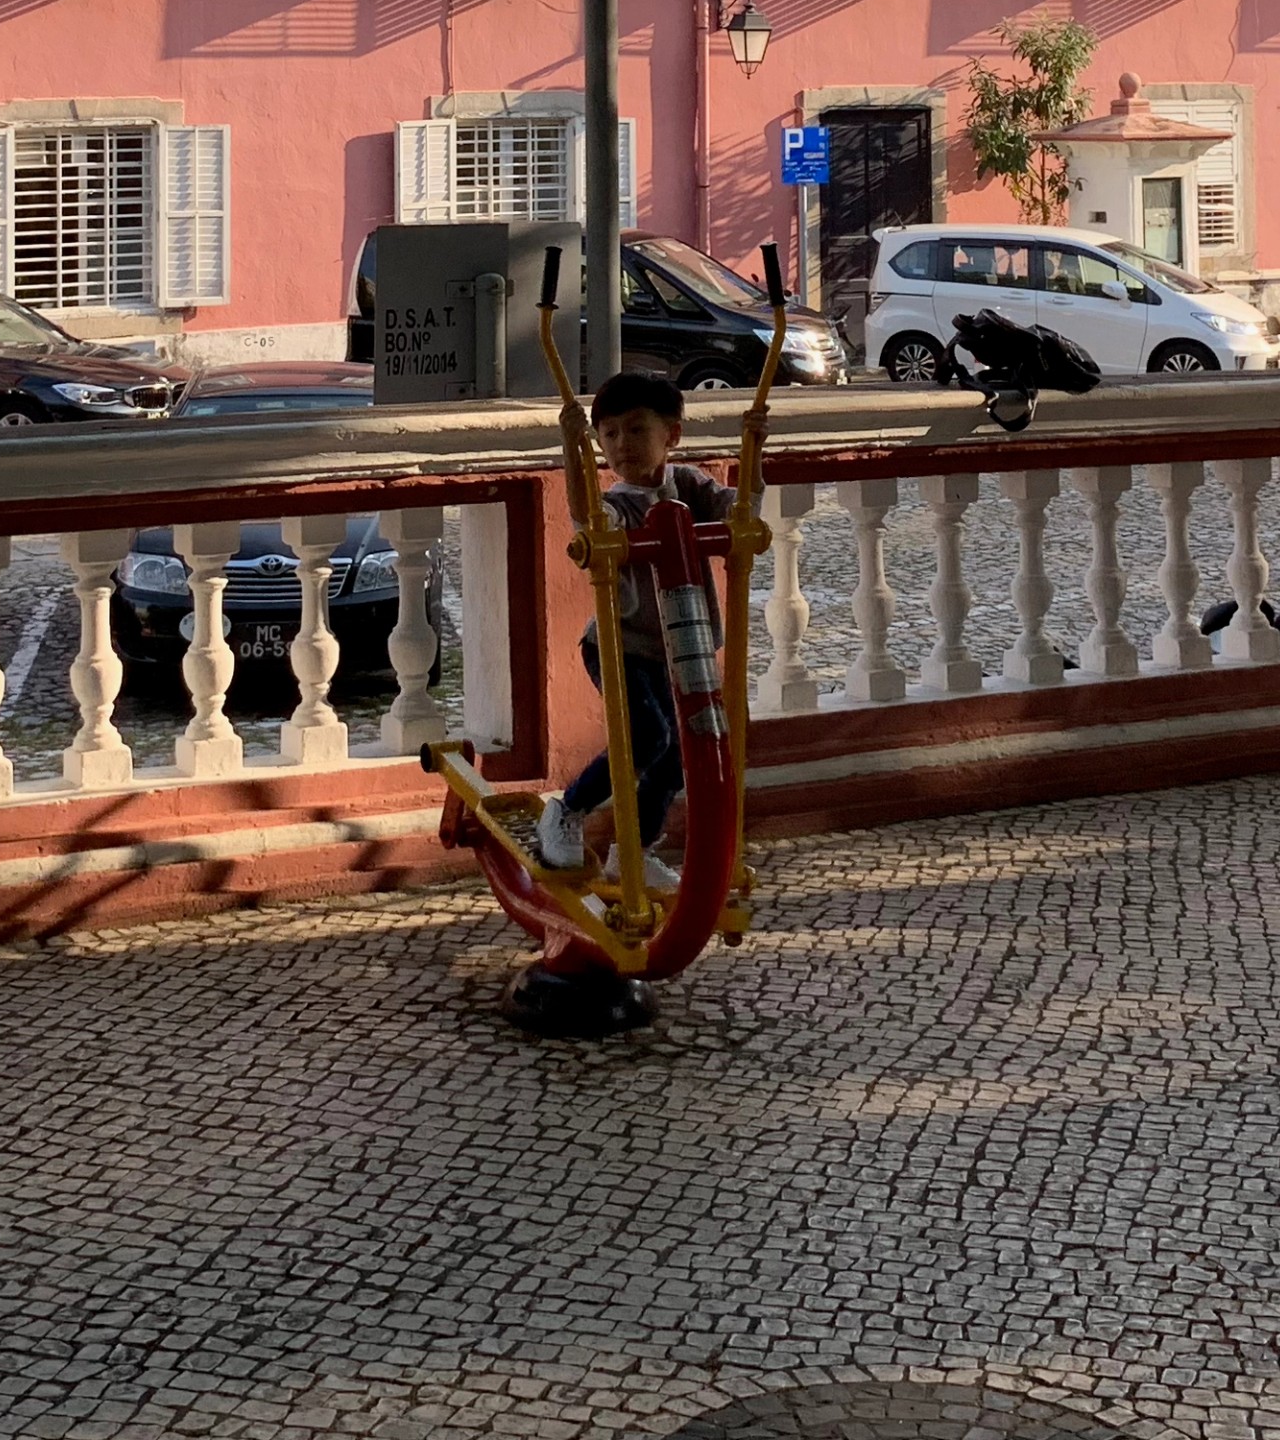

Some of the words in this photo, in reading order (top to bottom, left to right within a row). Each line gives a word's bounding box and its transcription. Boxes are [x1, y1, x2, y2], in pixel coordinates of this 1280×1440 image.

[785, 128, 804, 160] P
[244, 336, 276, 347] C-05
[256, 625, 281, 642] MC
